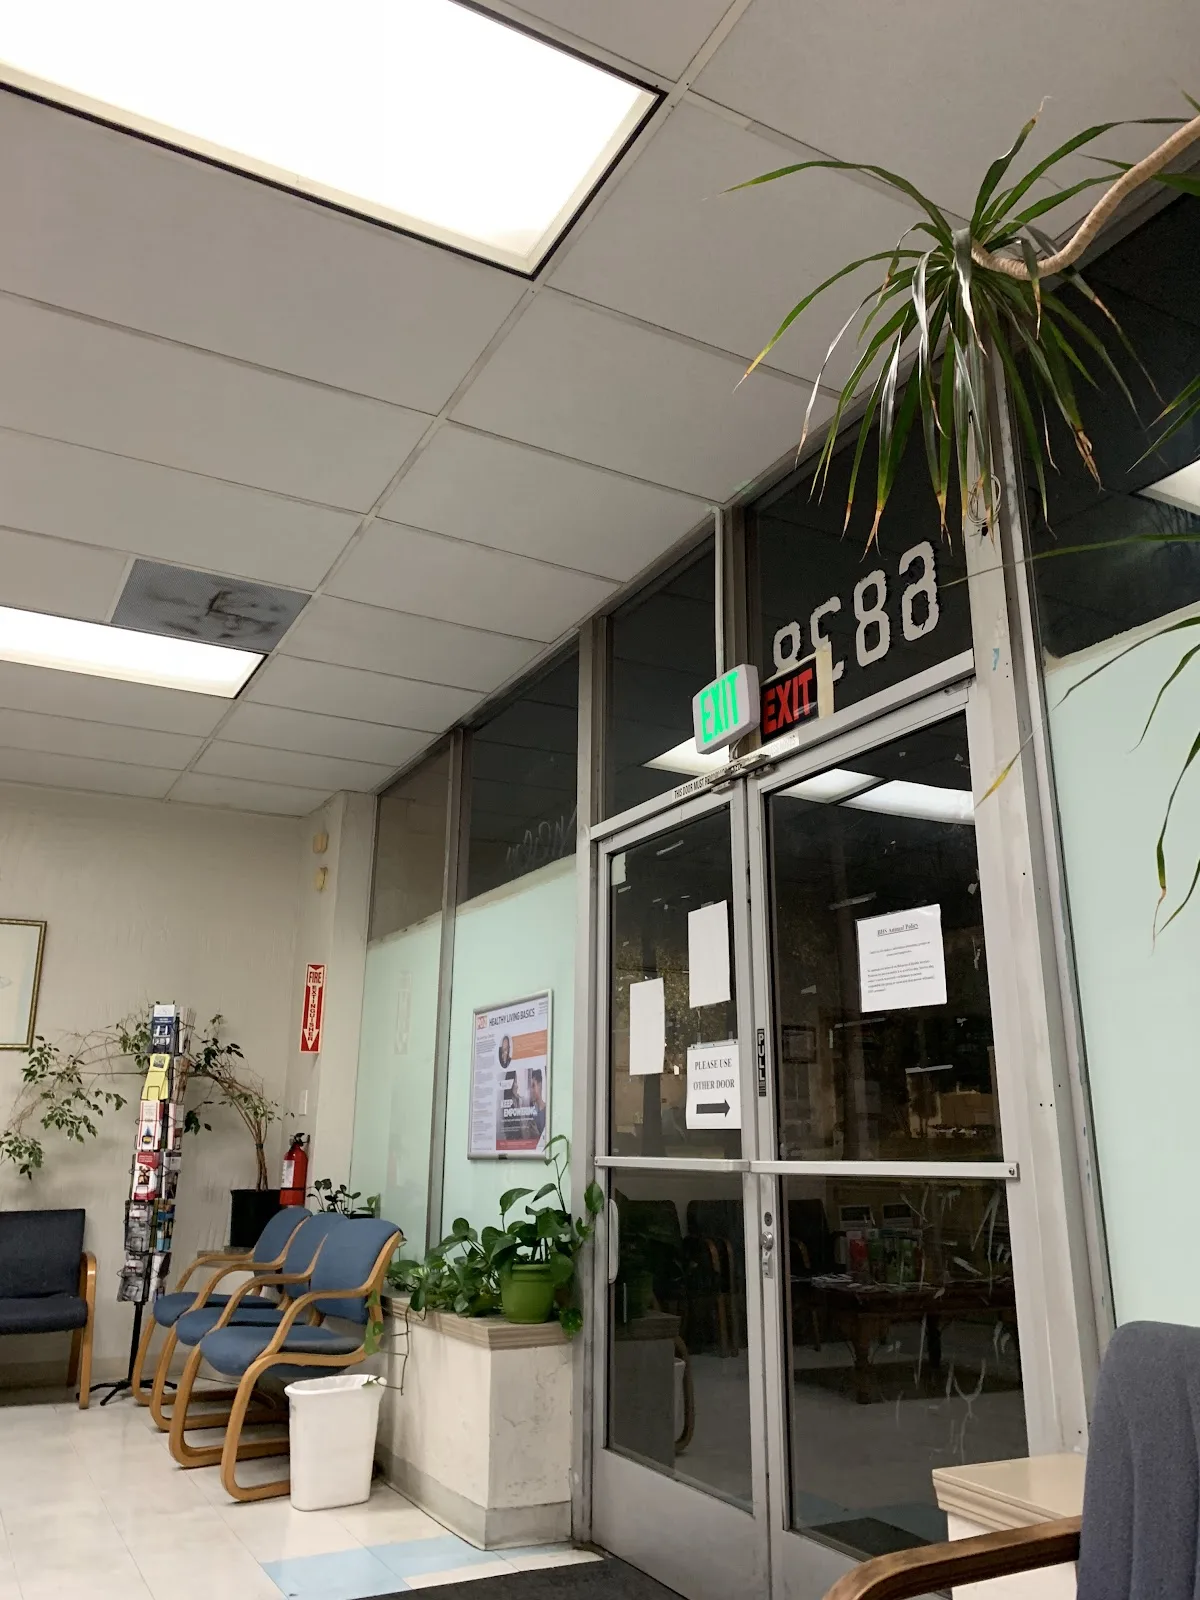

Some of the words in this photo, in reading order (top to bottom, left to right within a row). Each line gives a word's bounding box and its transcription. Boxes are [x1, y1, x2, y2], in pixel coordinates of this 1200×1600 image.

[699, 670, 740, 744] EXIT
[763, 667, 813, 736] EXIT
[674, 788, 683, 799] THIS
[682, 783, 693, 796] DOOR
[693, 777, 704, 791] MUST
[308, 971, 322, 984] FIRE
[308, 985, 317, 1042] EXTINGUISHER
[489, 1014, 507, 1027] HEALTHY
[506, 1011, 520, 1023] LIVING
[520, 1007, 535, 1020] BASICS
[694, 1059, 718, 1071] PLEASE
[719, 1058, 732, 1068] USE
[693, 1080, 715, 1091] OTHER
[716, 1078, 735, 1089] DOOR
